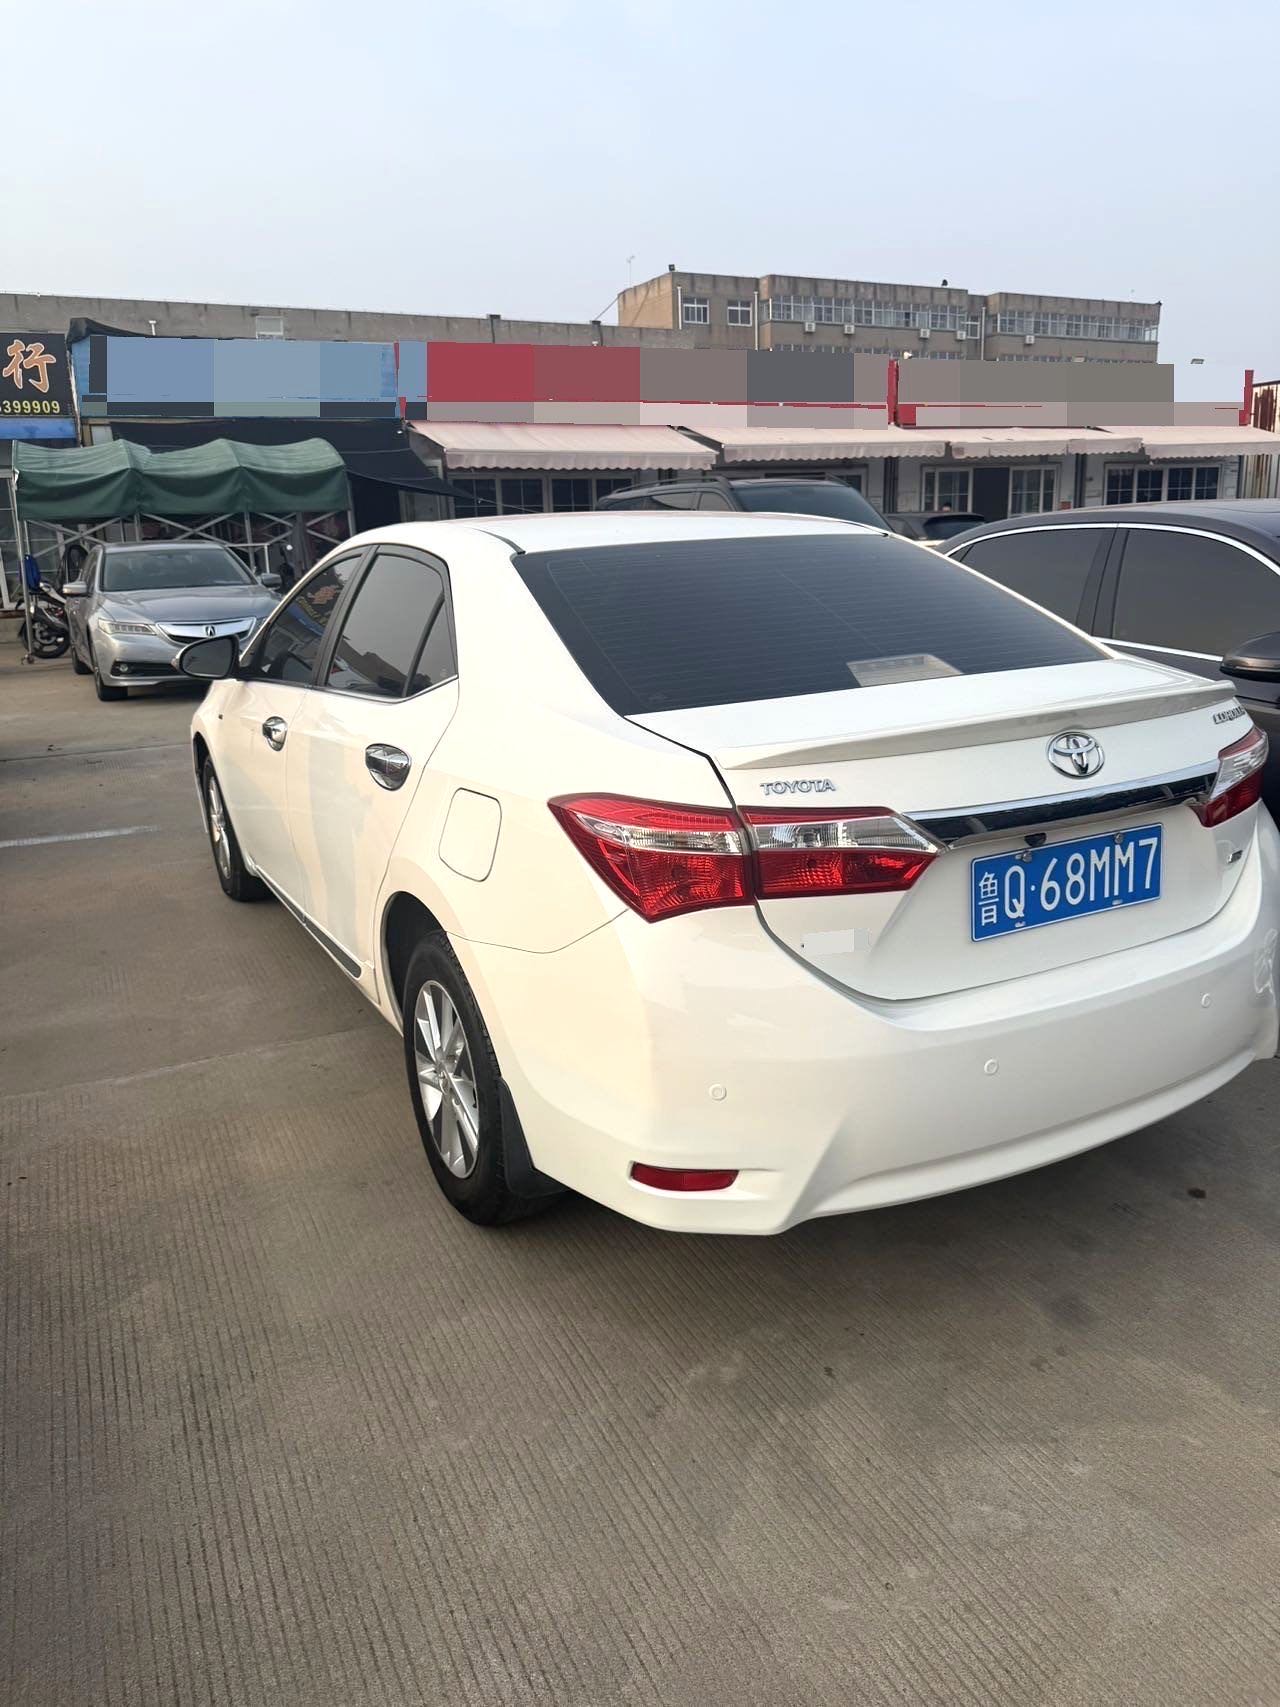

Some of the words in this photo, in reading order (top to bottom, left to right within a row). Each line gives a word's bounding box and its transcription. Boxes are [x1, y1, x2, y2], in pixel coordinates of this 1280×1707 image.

[2, 339, 57, 393] 行
[0, 400, 60, 414] 399909
[760, 779, 836, 796] TOYOTA
